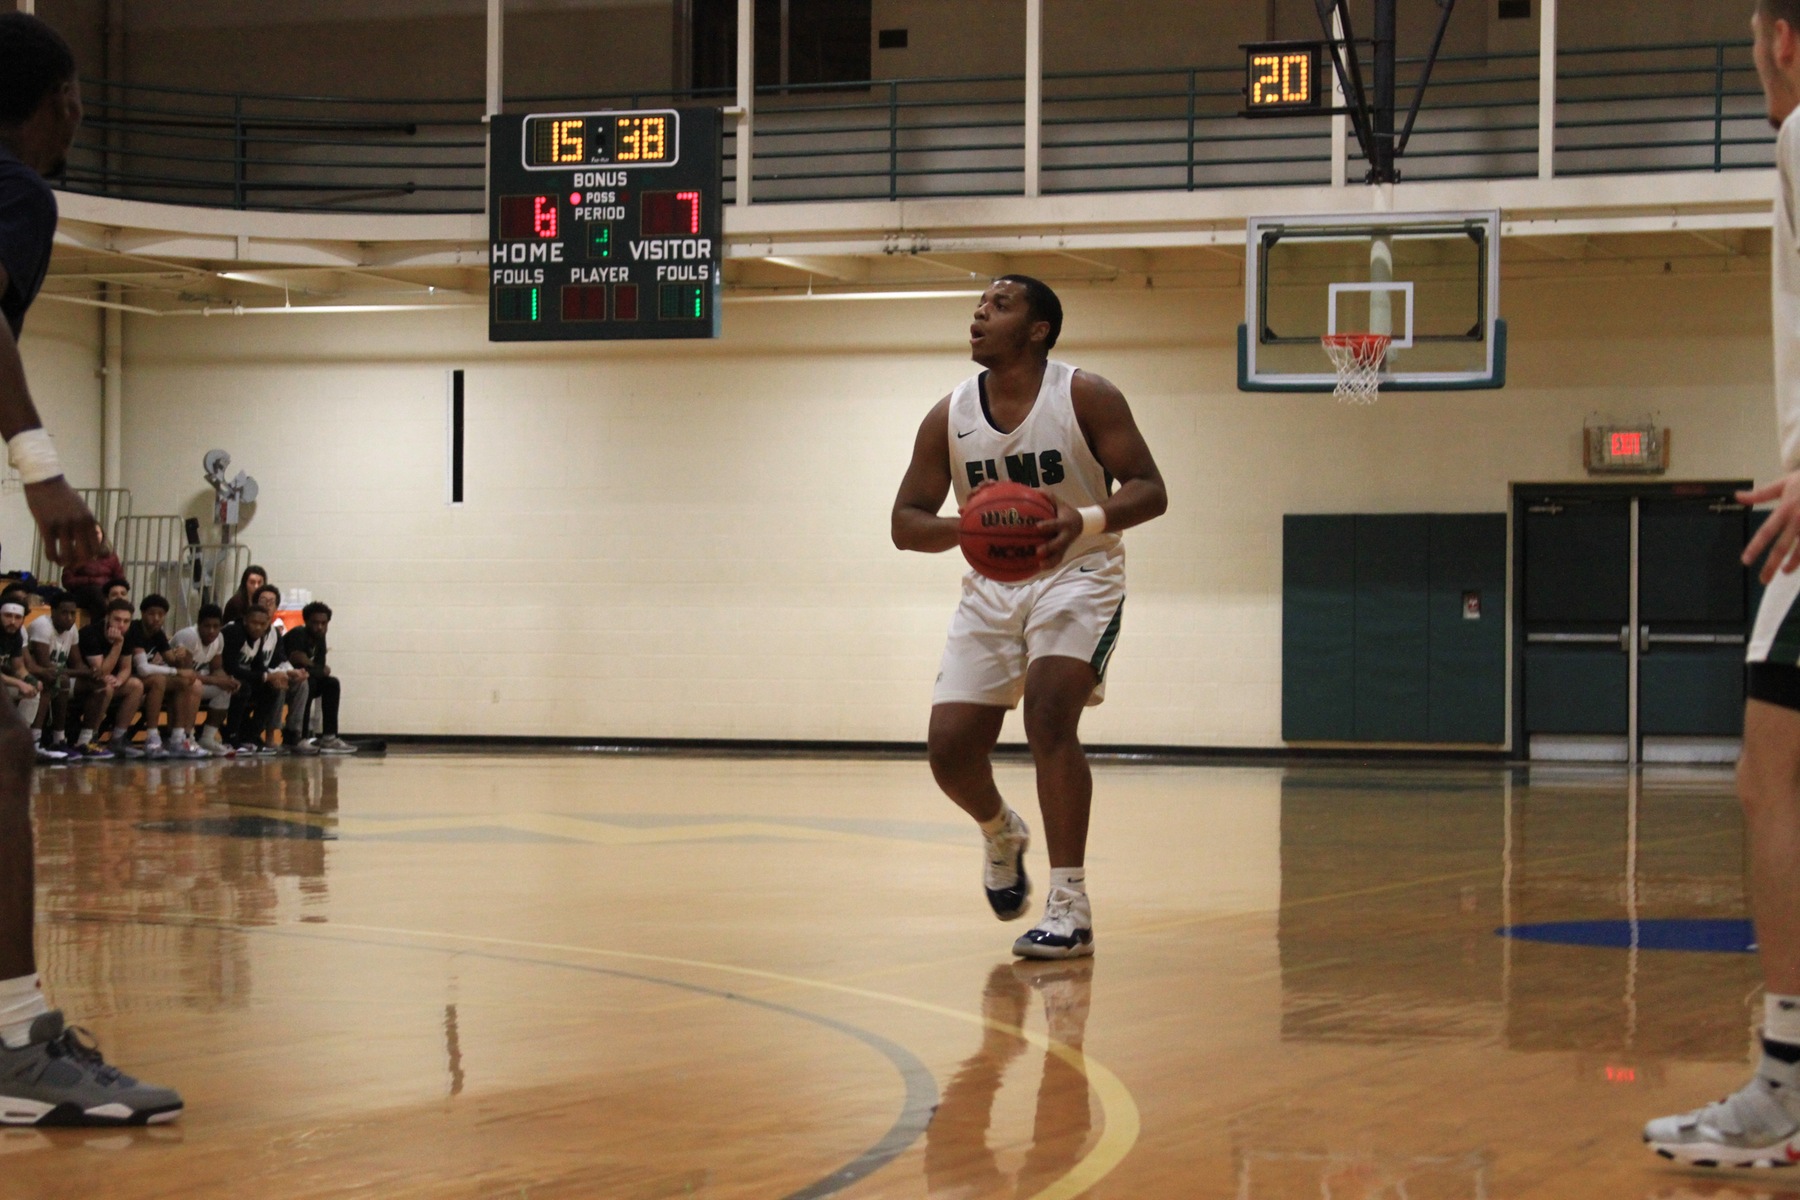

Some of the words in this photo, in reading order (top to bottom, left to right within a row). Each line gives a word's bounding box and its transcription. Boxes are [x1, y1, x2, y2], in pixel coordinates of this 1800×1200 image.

[1253, 54, 1308, 103] 20
[573, 171, 628, 188] BONUS
[586, 191, 616, 204] POSS
[574, 206, 626, 221] PERIOD
[676, 191, 699, 234] 7
[492, 242, 565, 264] HOME
[629, 238, 712, 261] VISITOR
[493, 268, 545, 285] FOULS
[570, 266, 630, 283] PLAYER
[656, 264, 709, 281] FOULS
[531, 287, 538, 321] 1
[1611, 432, 1642, 456] EXIT
